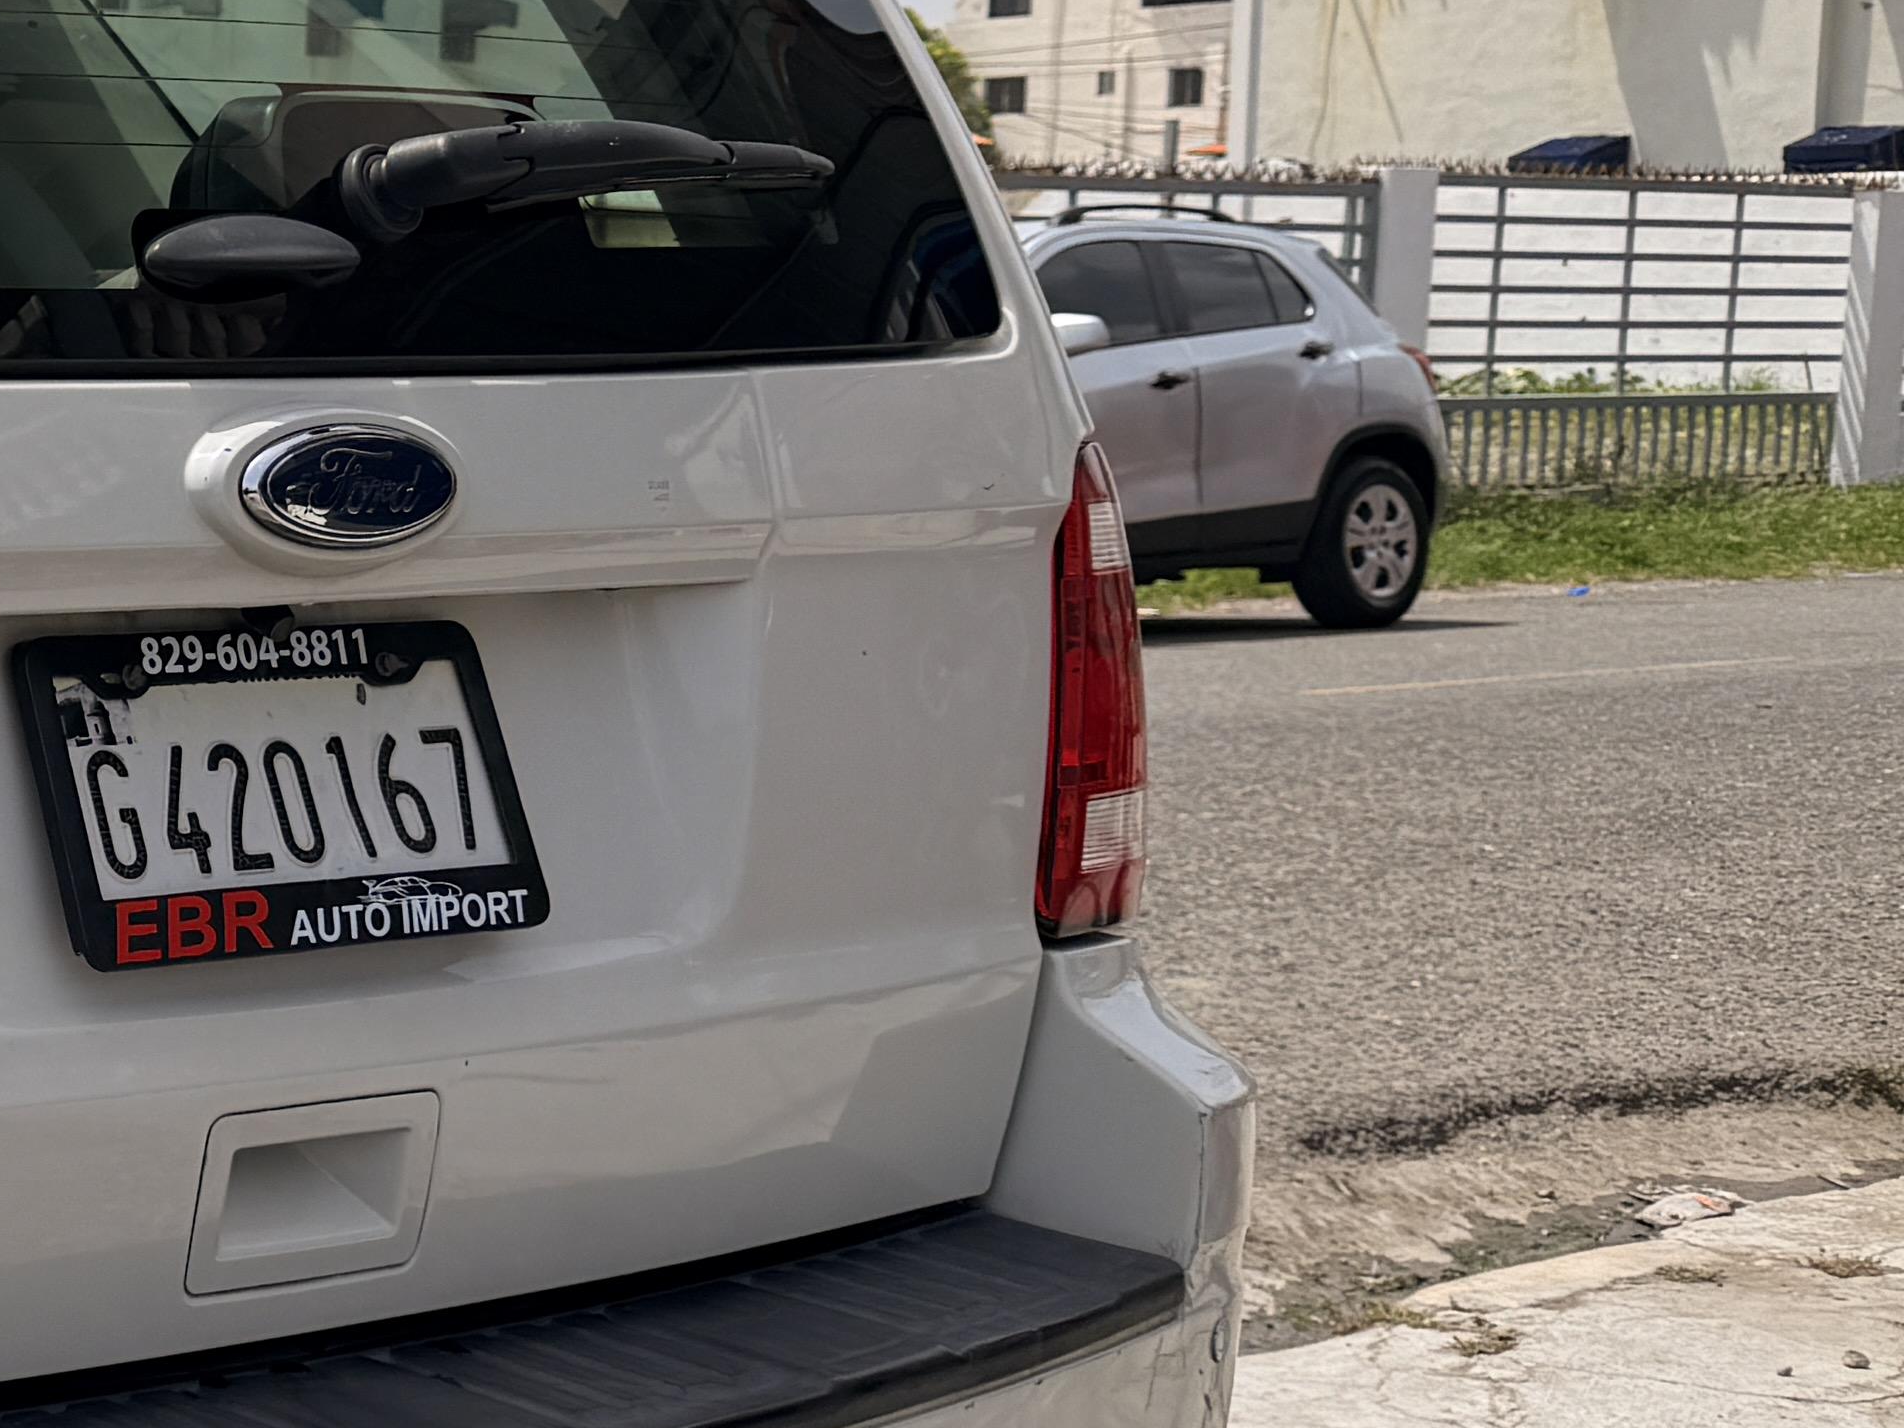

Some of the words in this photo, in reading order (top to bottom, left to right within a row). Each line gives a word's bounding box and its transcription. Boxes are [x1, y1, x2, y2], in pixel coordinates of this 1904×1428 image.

[306, 447, 422, 514] Ford
[140, 628, 369, 675] 829-604-8811
[86, 727, 478, 880] G420167
[115, 890, 274, 965] EBR
[291, 902, 392, 946] AUTO
[402, 889, 529, 935] IMPORT
